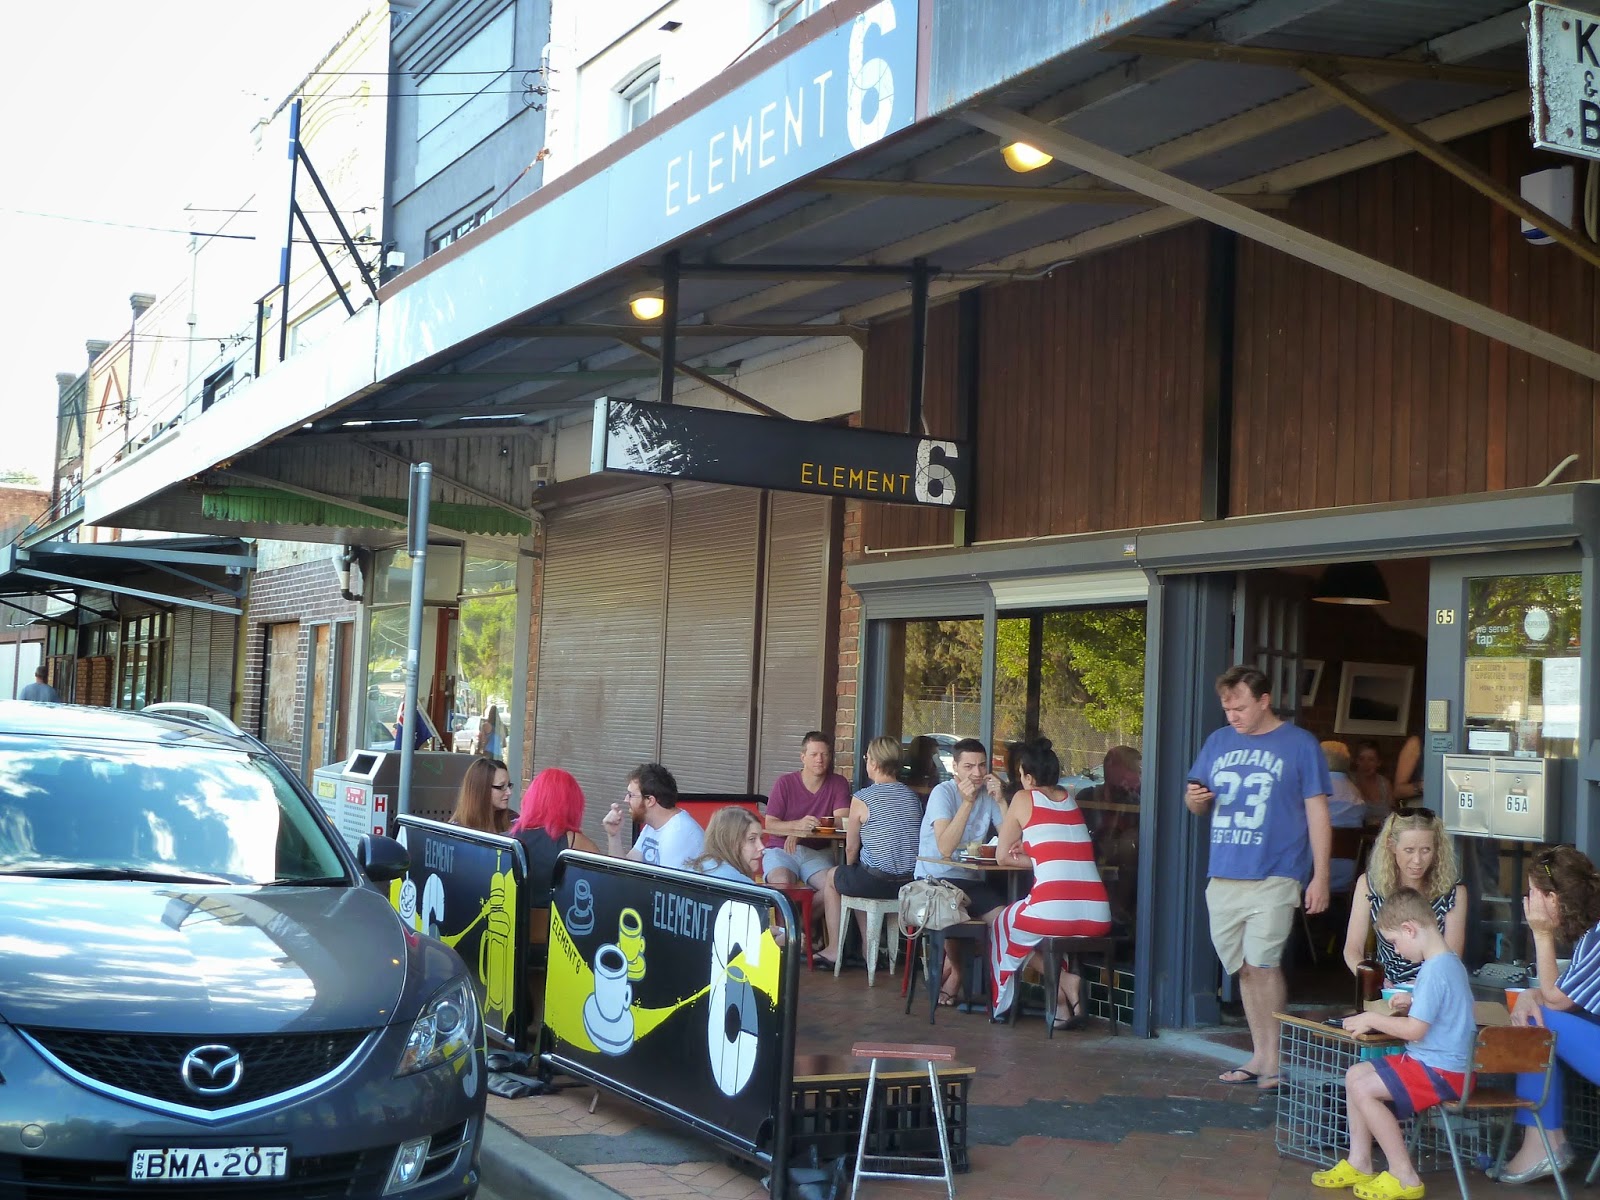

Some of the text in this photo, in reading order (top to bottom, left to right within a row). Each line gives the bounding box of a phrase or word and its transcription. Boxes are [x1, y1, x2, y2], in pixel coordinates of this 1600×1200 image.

[666, 0, 897, 217] ELEMENT 6
[801, 438, 960, 506] ELEMENT 6
[1436, 610, 1453, 624] 65
[1476, 625, 1509, 634] we serve
[1476, 633, 1493, 648] tap
[1210, 749, 1284, 782] INDIANA
[1212, 773, 1273, 829] 23
[1460, 793, 1473, 808] 65
[1506, 796, 1528, 812] 65A
[425, 837, 455, 874] ELEMENT
[652, 891, 713, 941] ELEMENT
[552, 915, 577, 966] ELEMENT
